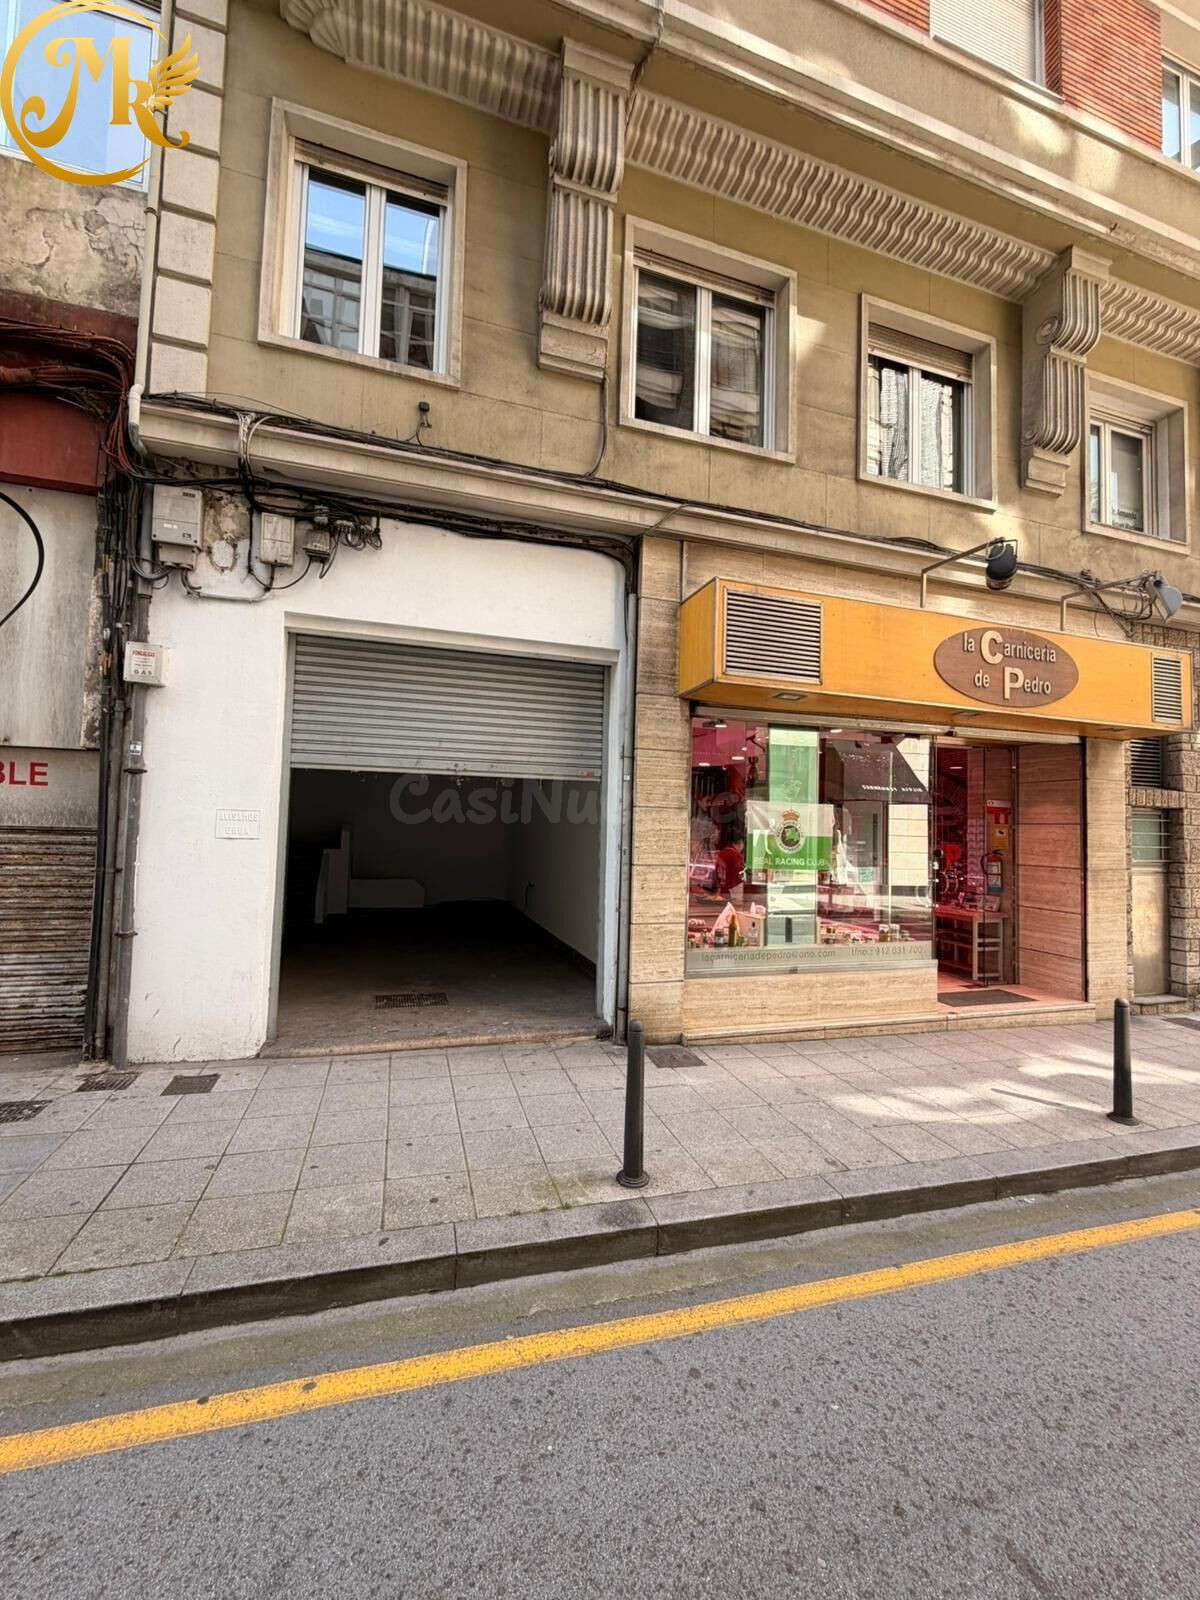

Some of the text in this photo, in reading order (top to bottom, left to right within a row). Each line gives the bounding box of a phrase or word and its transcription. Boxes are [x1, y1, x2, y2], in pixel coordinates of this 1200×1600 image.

[963, 632, 975, 652] la
[974, 666, 1052, 700] de Pedro
[753, 857, 825, 867] REAL RACING CLUB
